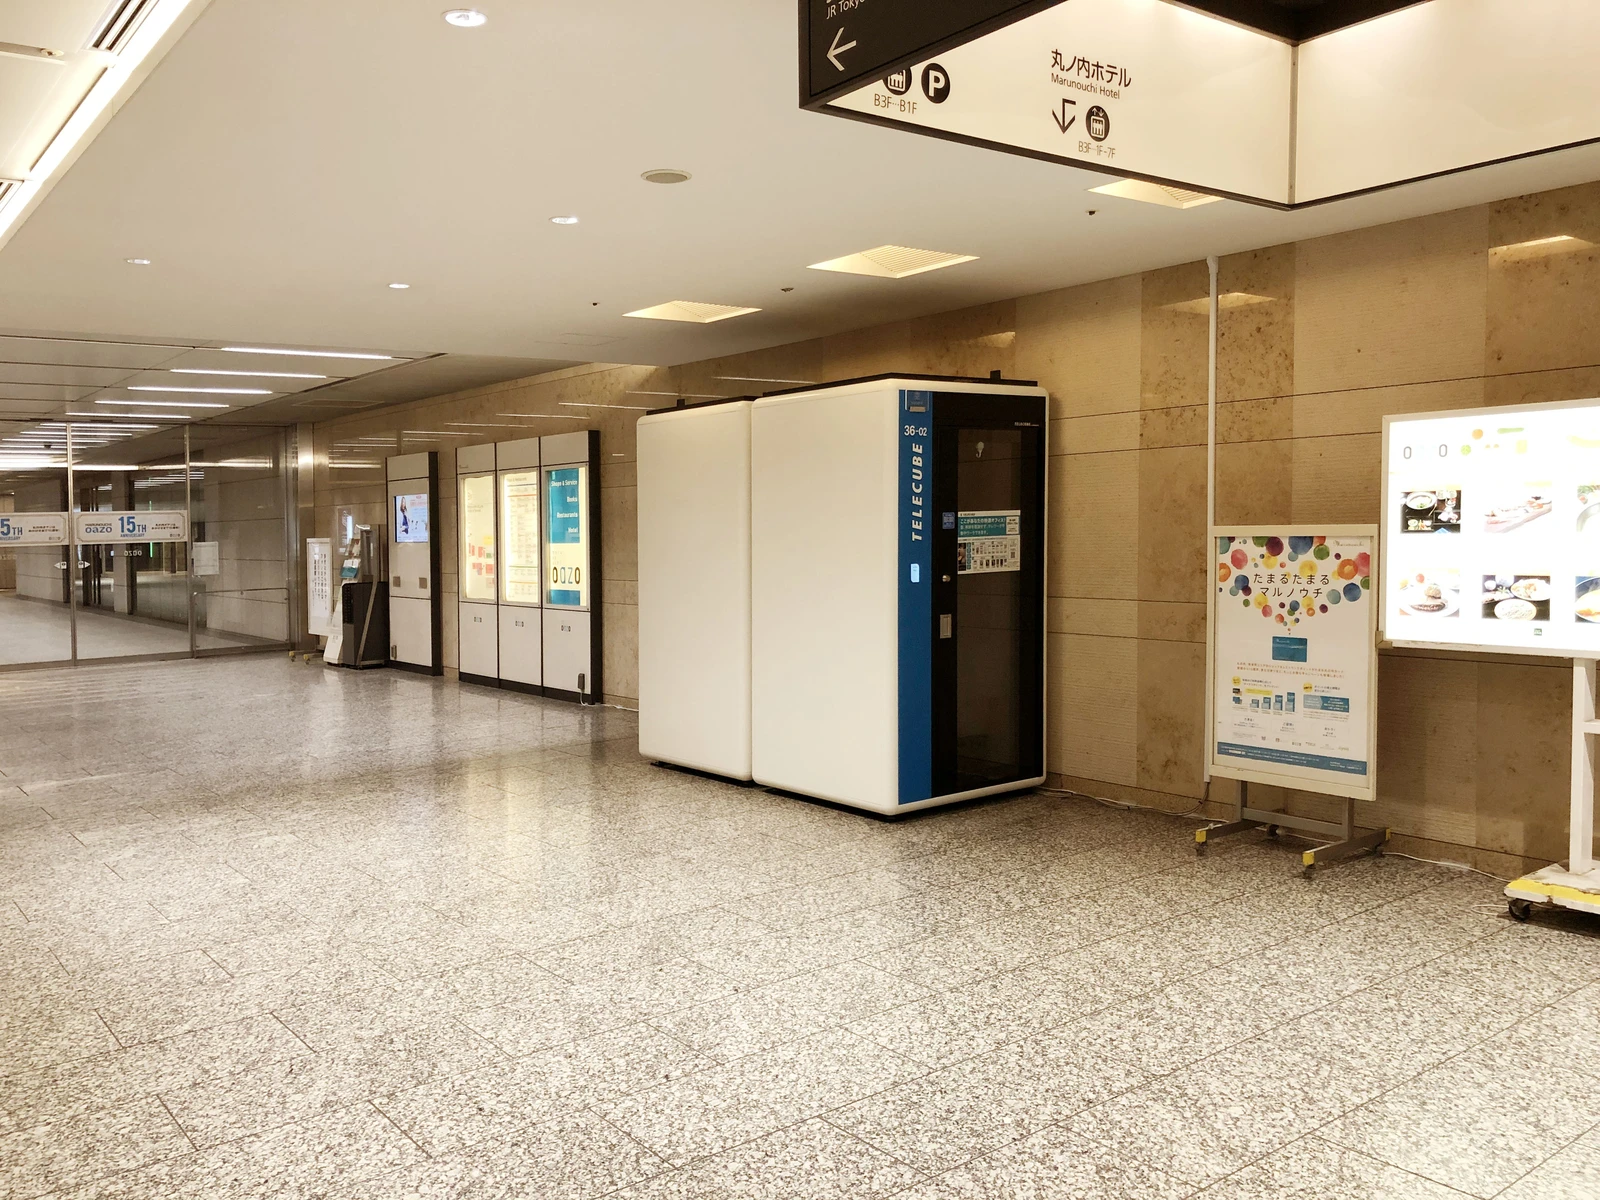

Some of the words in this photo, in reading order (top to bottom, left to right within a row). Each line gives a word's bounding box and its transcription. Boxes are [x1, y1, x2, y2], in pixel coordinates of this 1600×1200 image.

[826, 4, 837, 20] JR
[1051, 48, 1132, 88] 丸ノ内ホテル
[1051, 72, 1098, 94] Marunouchi
[1099, 86, 1121, 99] Hotel
[904, 425, 928, 437] 36-02
[911, 443, 923, 542] TELECUBE
[556, 511, 578, 519] Restaurants
[85, 526, 113, 534] oazo
[1253, 573, 1330, 586] たまるたまる
[1260, 586, 1323, 599] マルノウチ
